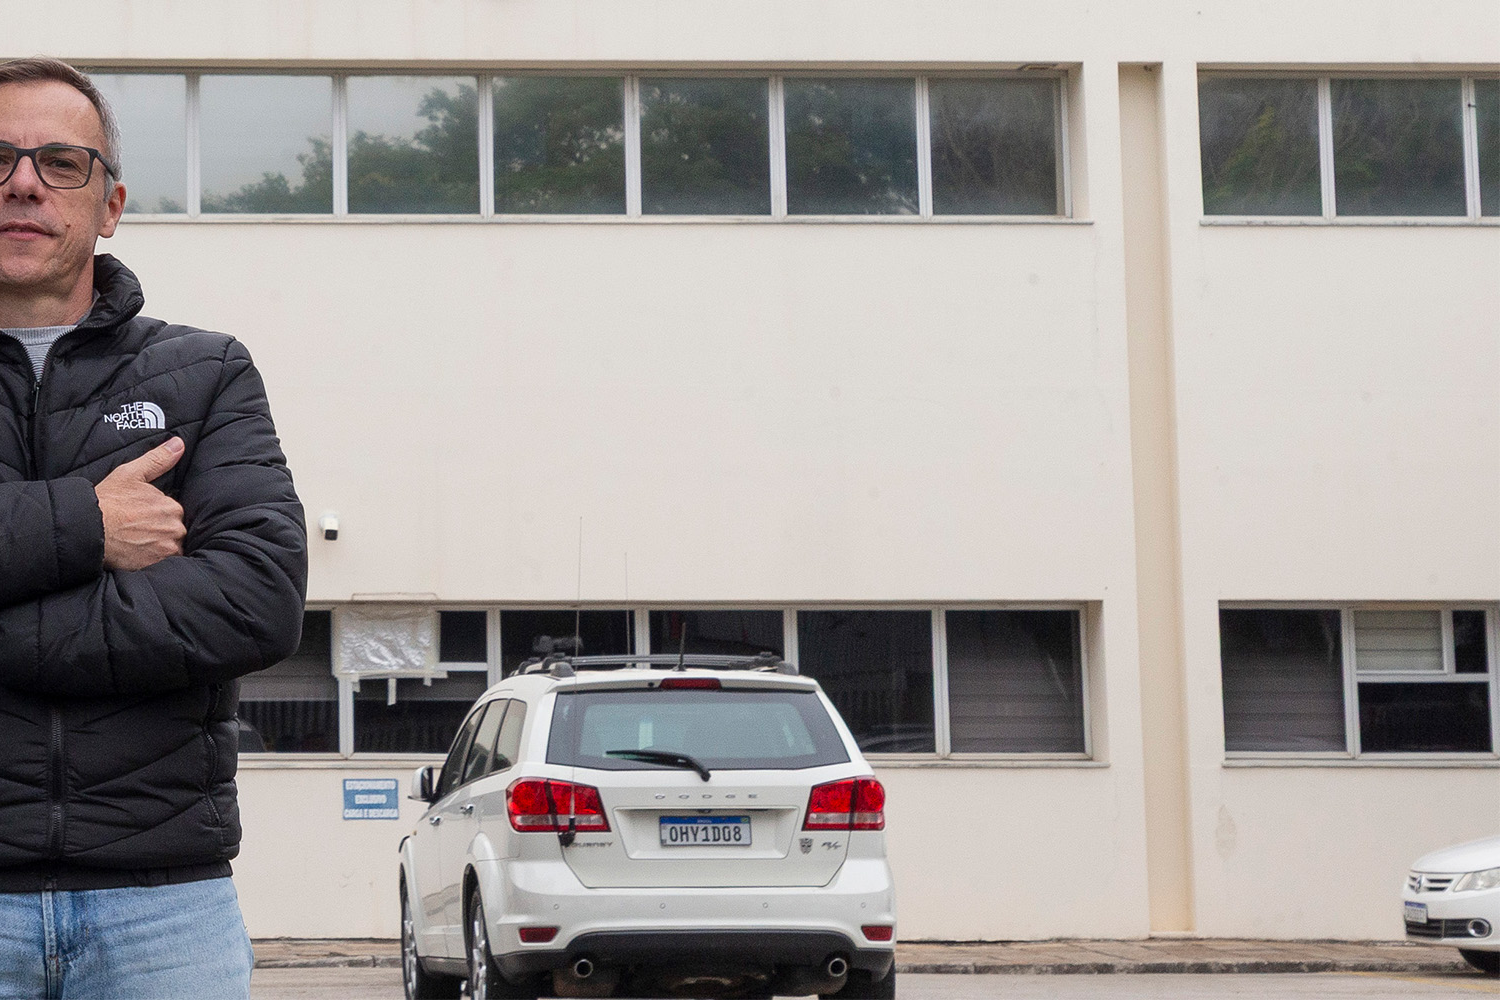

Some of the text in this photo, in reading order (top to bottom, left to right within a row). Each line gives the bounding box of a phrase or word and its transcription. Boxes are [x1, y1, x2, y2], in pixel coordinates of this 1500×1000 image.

[120, 401, 144, 413] THE
[103, 410, 144, 423] NORTH
[116, 418, 145, 430] FACE
